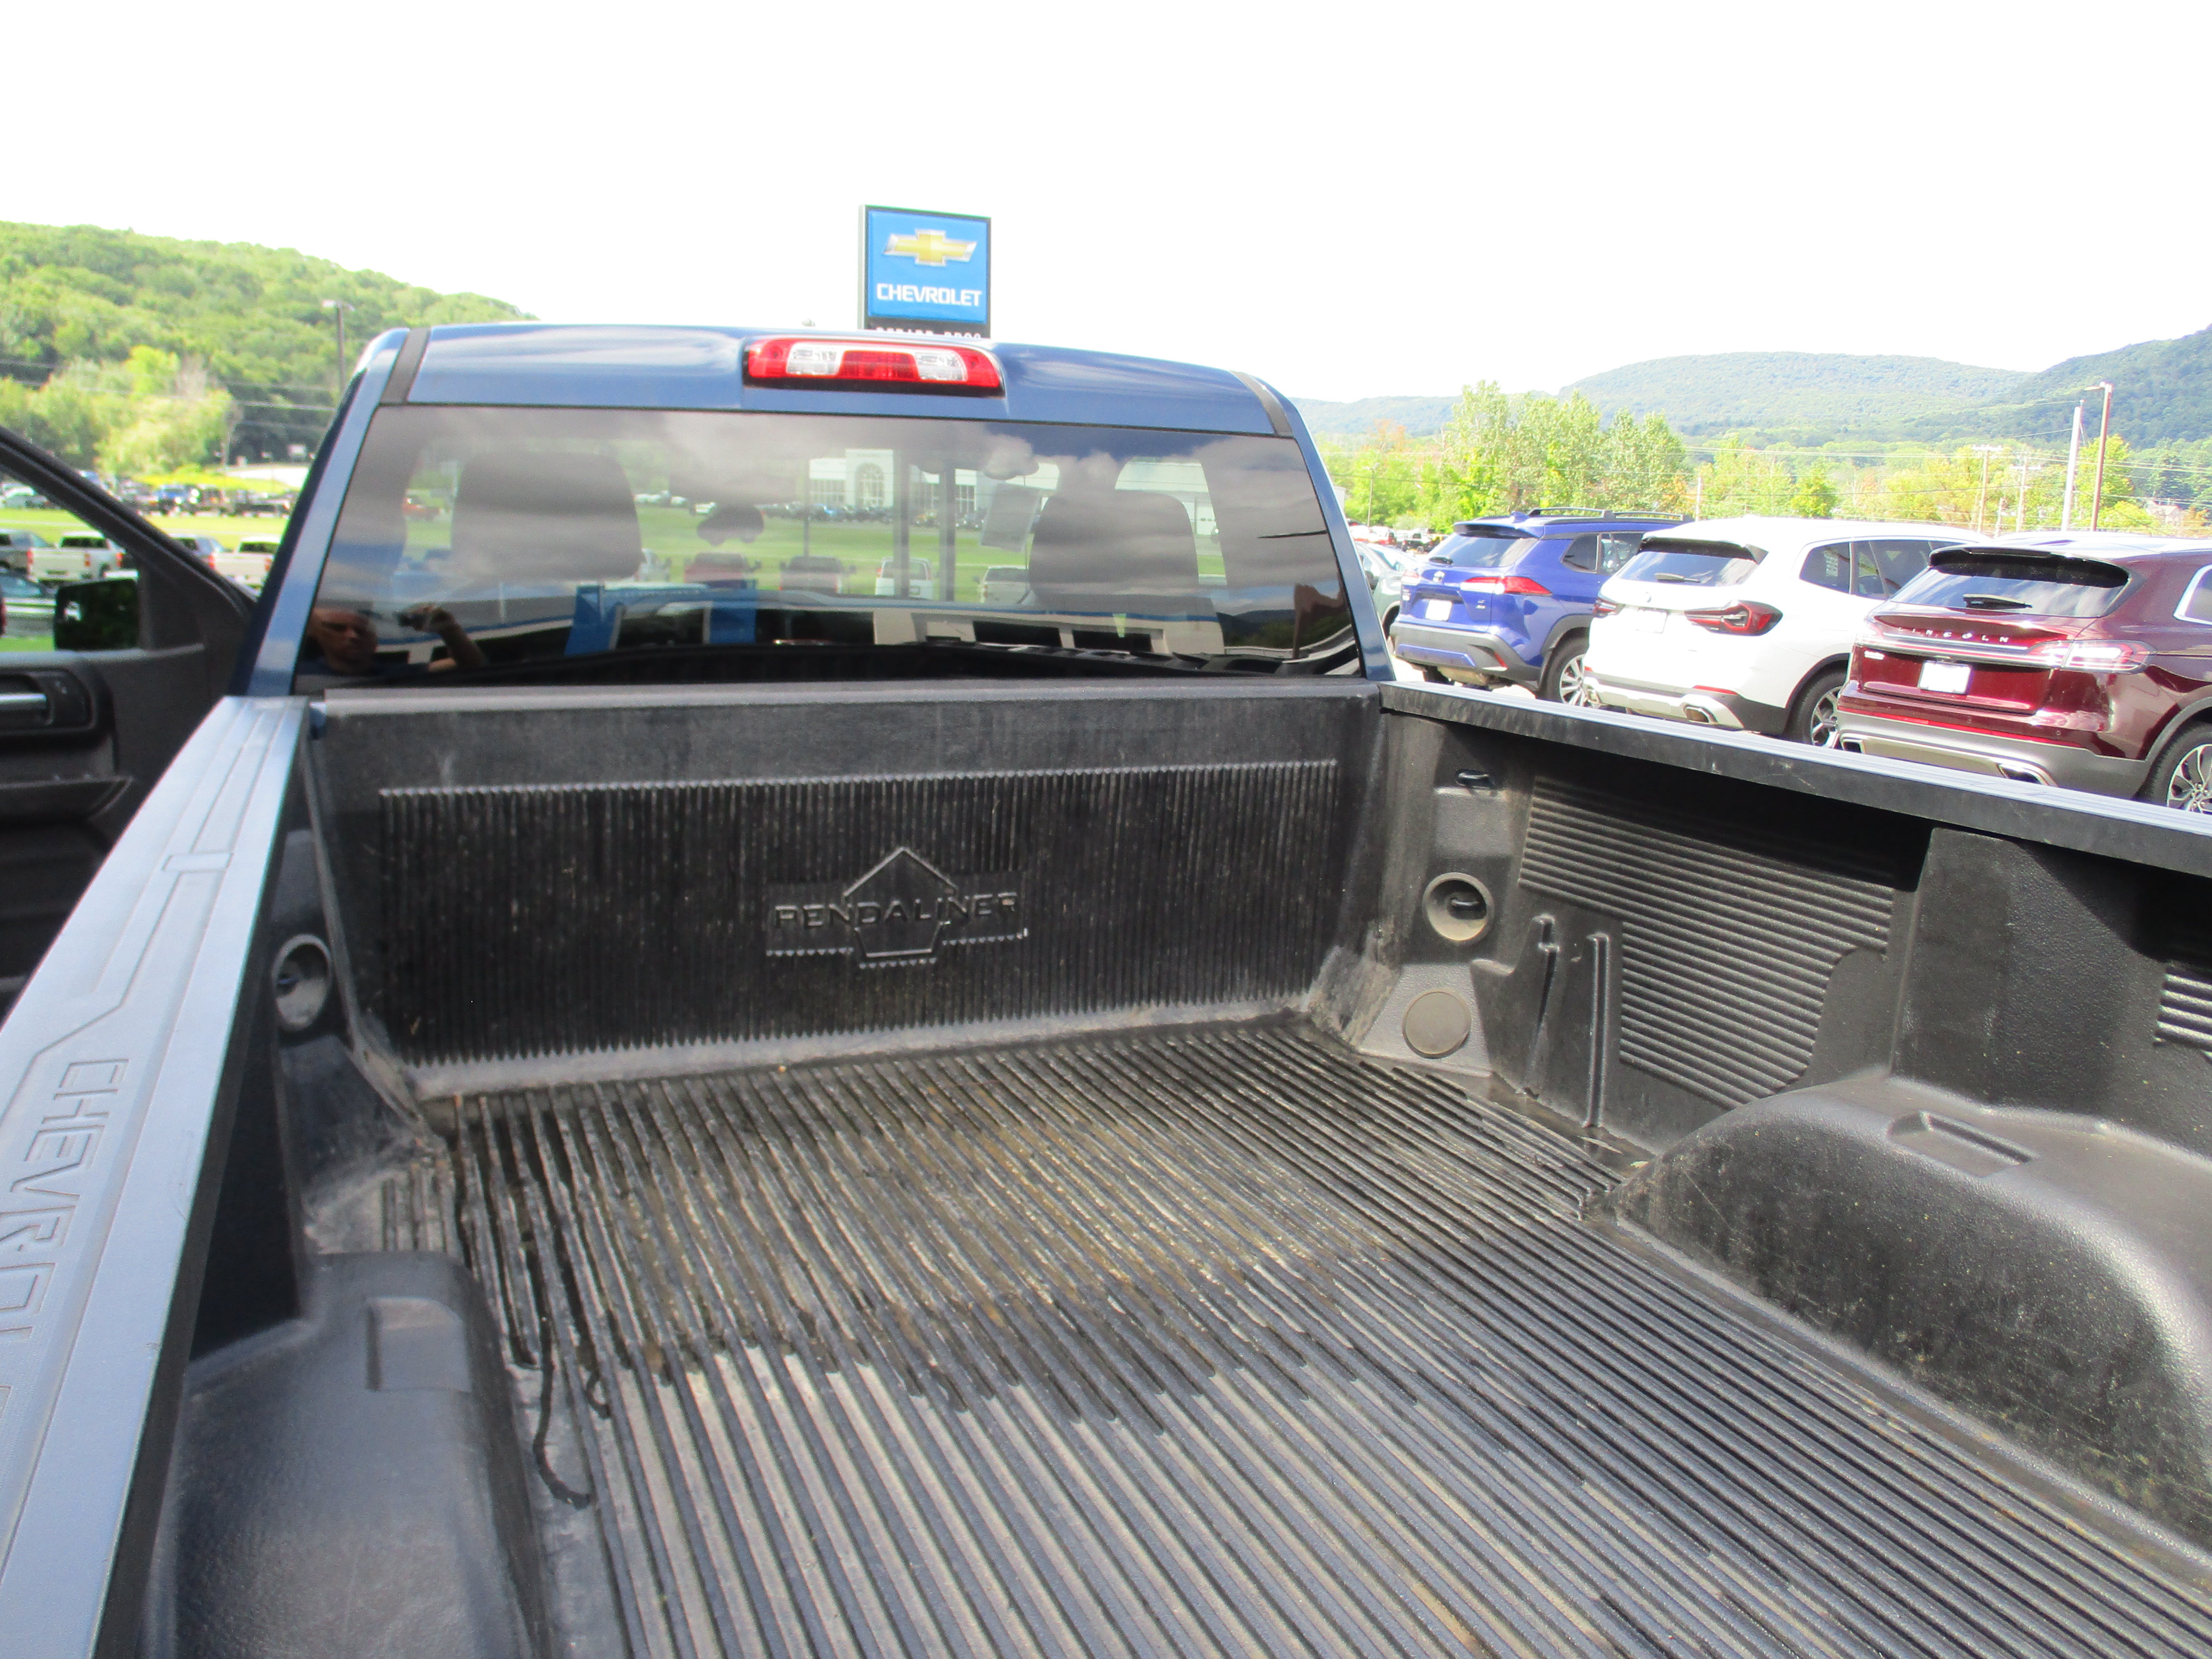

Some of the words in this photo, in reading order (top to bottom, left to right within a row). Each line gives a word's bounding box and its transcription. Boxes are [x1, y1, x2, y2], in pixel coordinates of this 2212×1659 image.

[877, 283, 982, 307] CHEVROLET
[1898, 626, 2009, 643] LINCOLN
[775, 891, 1018, 930] PENDALINER
[0, 1058, 130, 1419] CHEVRO
